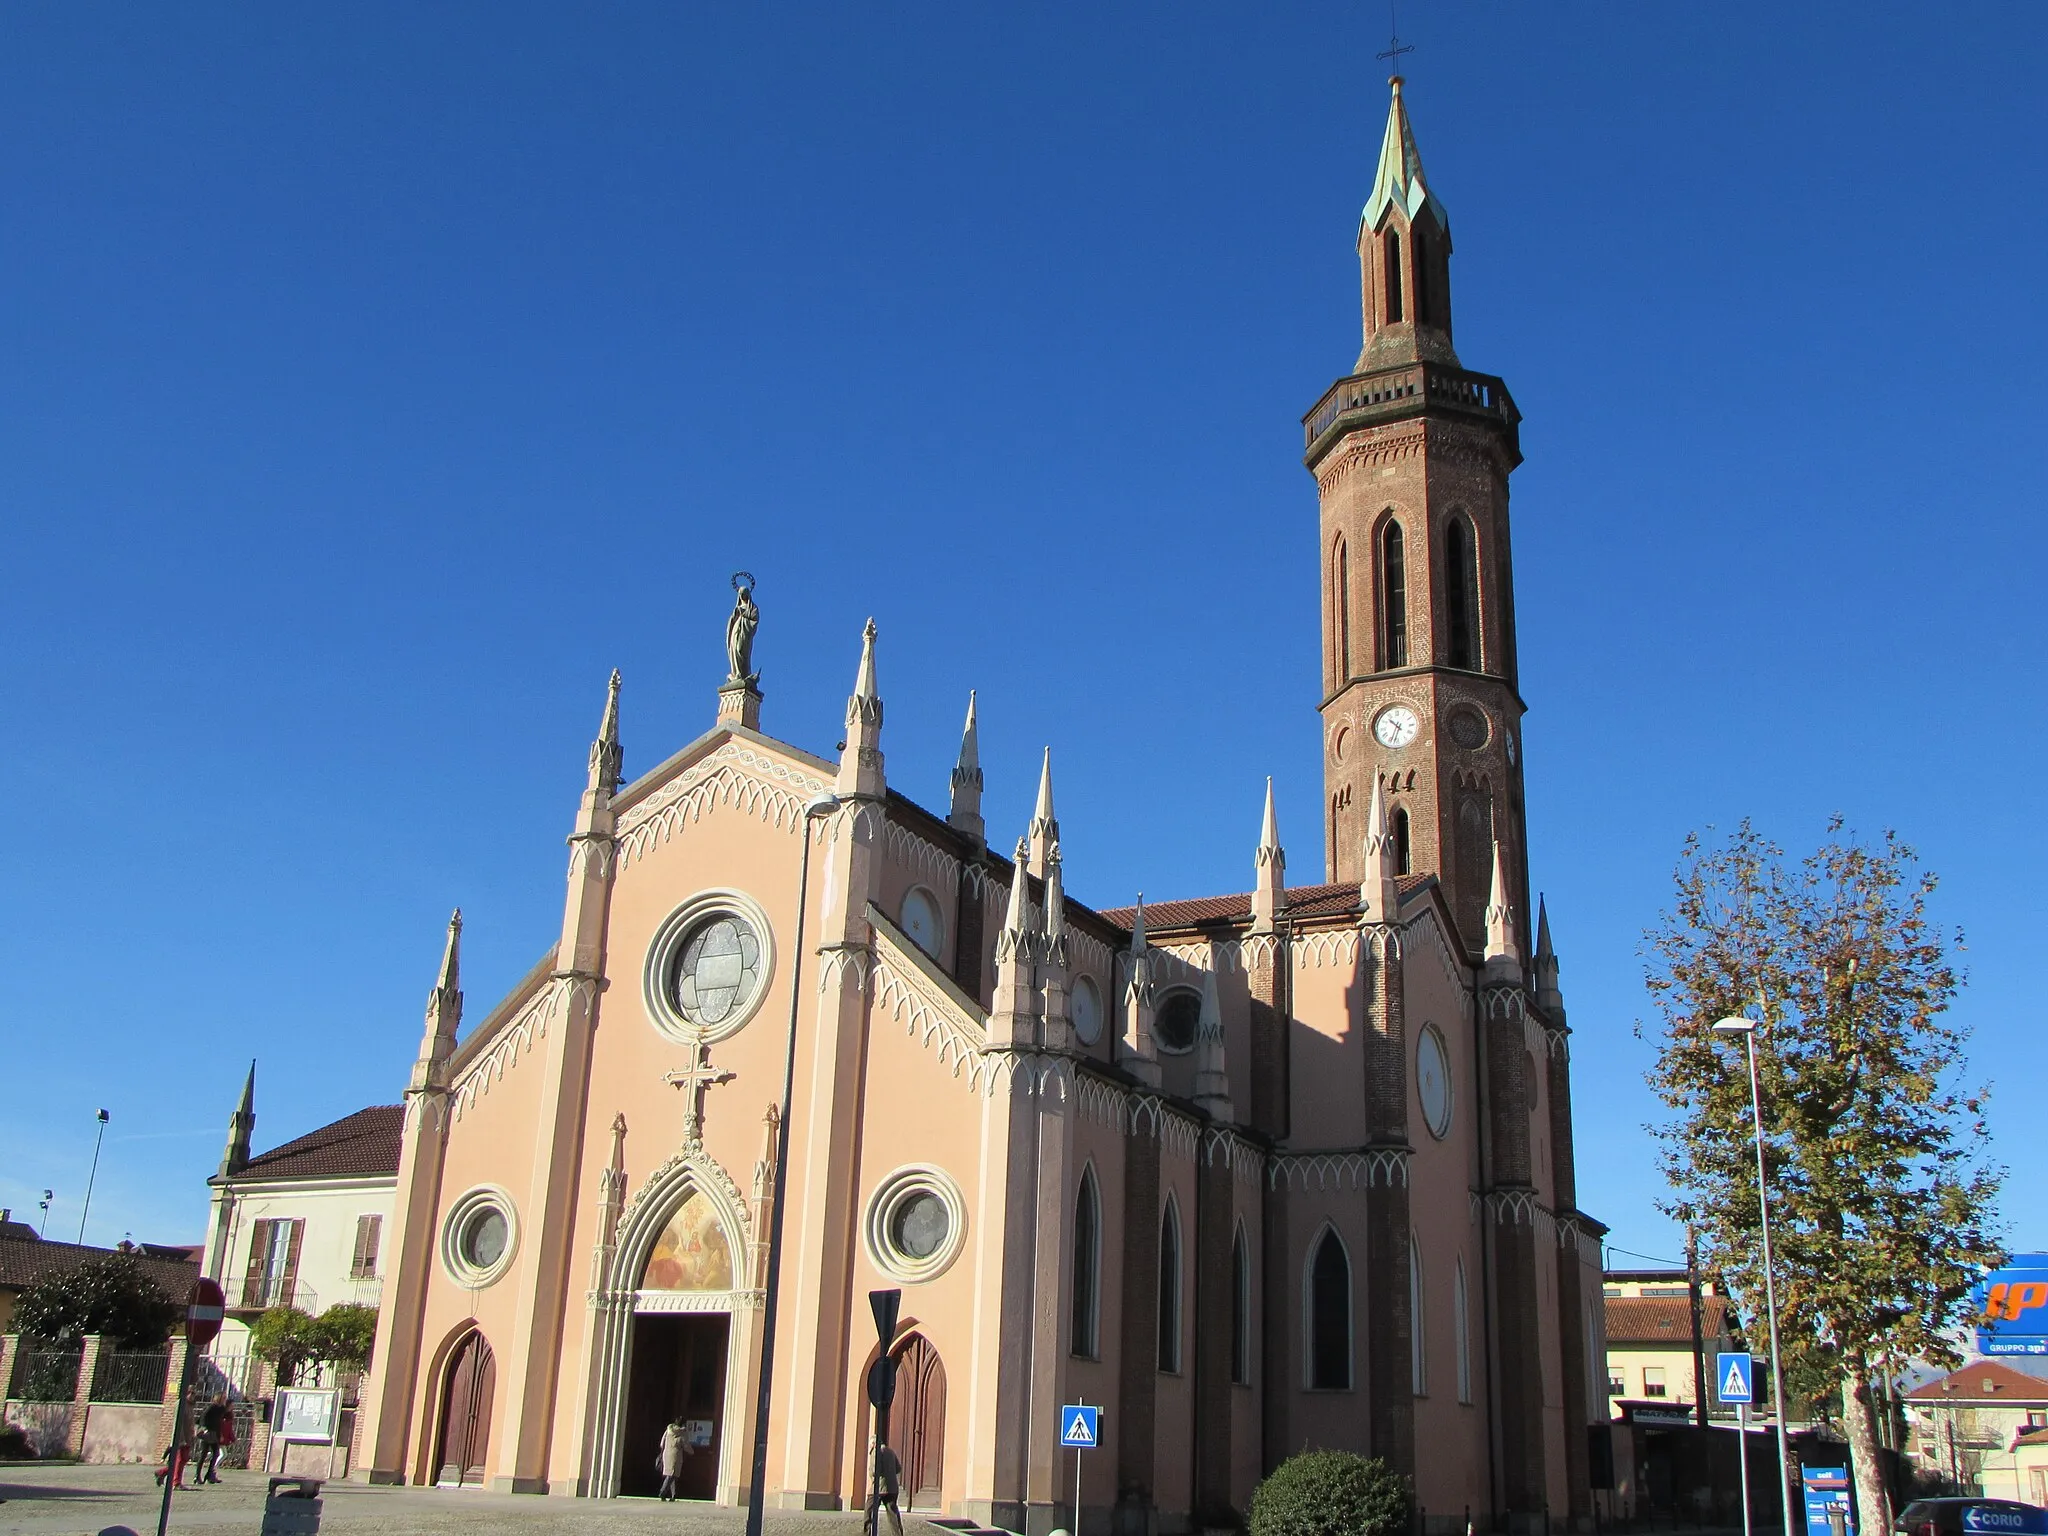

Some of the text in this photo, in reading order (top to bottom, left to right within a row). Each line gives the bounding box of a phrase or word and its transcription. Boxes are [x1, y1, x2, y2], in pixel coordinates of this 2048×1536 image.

[1989, 1340, 2046, 1354] GRUPPO api
[1982, 1513, 2023, 1527] CORIO
